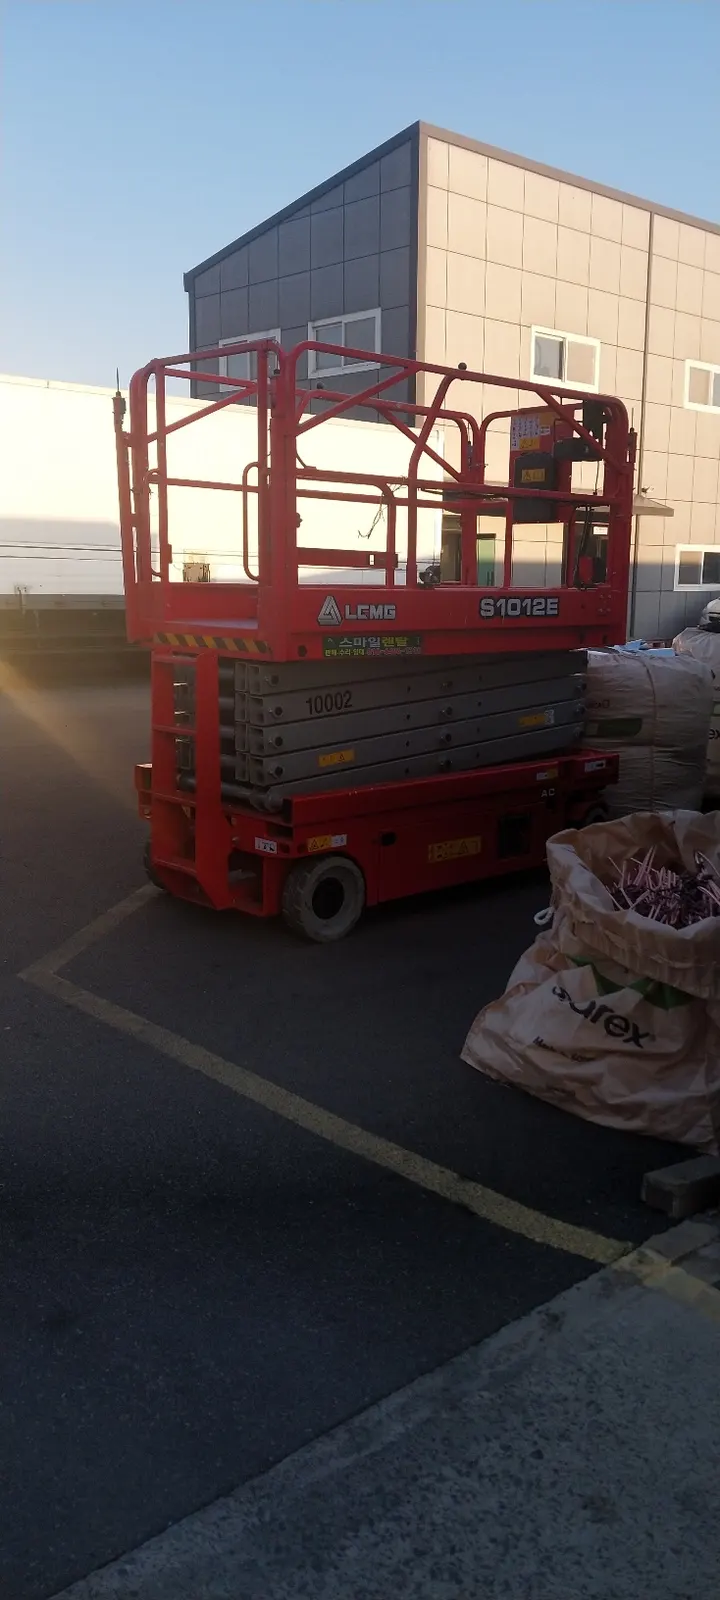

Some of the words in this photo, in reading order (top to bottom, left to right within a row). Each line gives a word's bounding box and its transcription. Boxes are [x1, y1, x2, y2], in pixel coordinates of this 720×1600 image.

[344, 604, 396, 620] LGMG
[479, 596, 560, 618] S1012E
[338, 636, 407, 648] 스마일렌탈
[306, 690, 353, 715] 10002
[540, 788, 556, 798] AC
